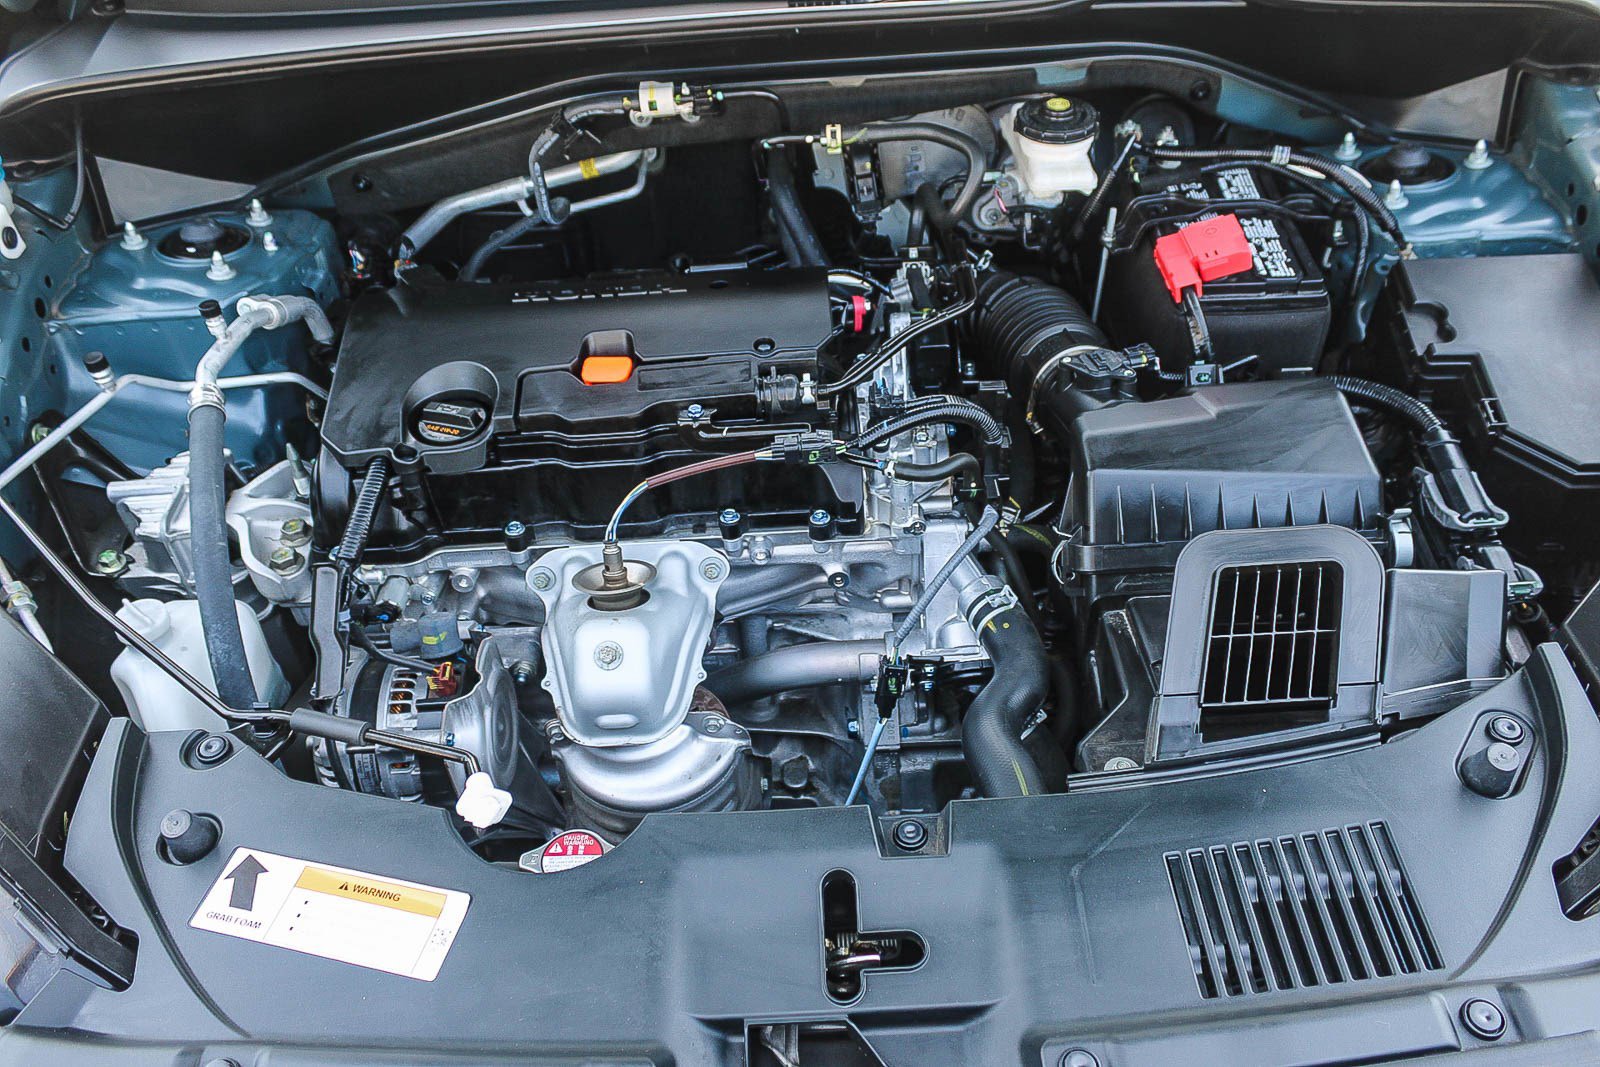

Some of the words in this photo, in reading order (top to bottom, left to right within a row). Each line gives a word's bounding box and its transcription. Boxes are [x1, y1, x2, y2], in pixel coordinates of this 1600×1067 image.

[353, 884, 402, 902] WARNING
[206, 911, 233, 923] GRAB
[234, 917, 262, 929] FOAM
